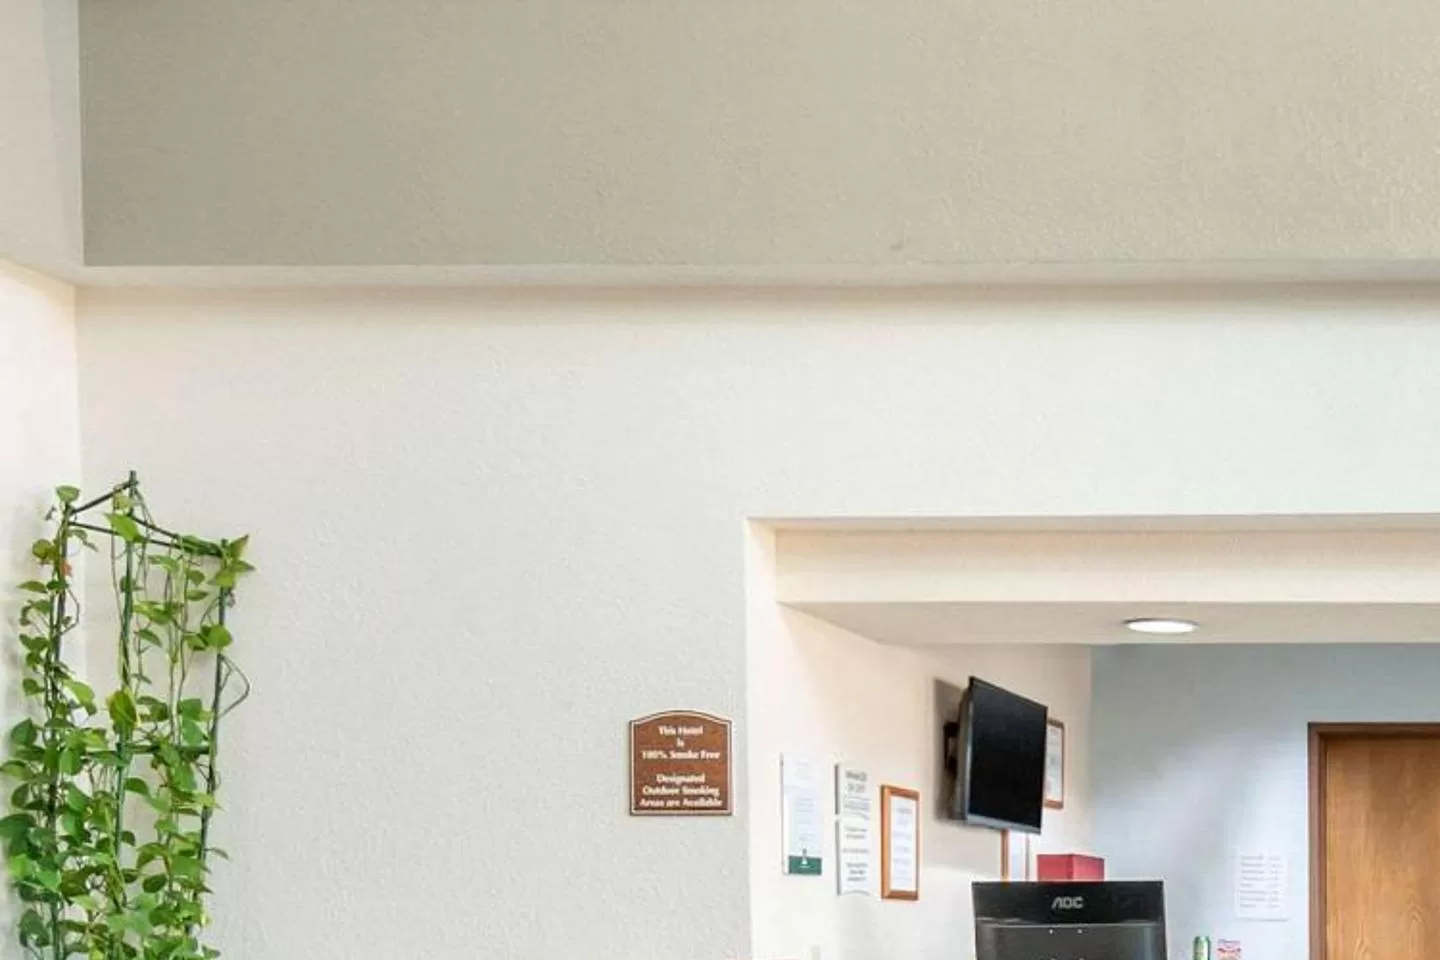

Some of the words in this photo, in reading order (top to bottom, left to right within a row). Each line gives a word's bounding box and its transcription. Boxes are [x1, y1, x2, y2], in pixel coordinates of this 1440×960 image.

[658, 725, 677, 736] This
[678, 726, 704, 735] Hotel
[669, 750, 699, 760] Smoke
[700, 750, 720, 760] Free
[656, 772, 706, 786] Designated
[642, 785, 680, 796] Outdoor
[681, 785, 720, 798] Smoking
[639, 798, 665, 808] Areas
[665, 799, 681, 808] are
[682, 797, 722, 808] Available
[1051, 896, 1084, 909] AOC
